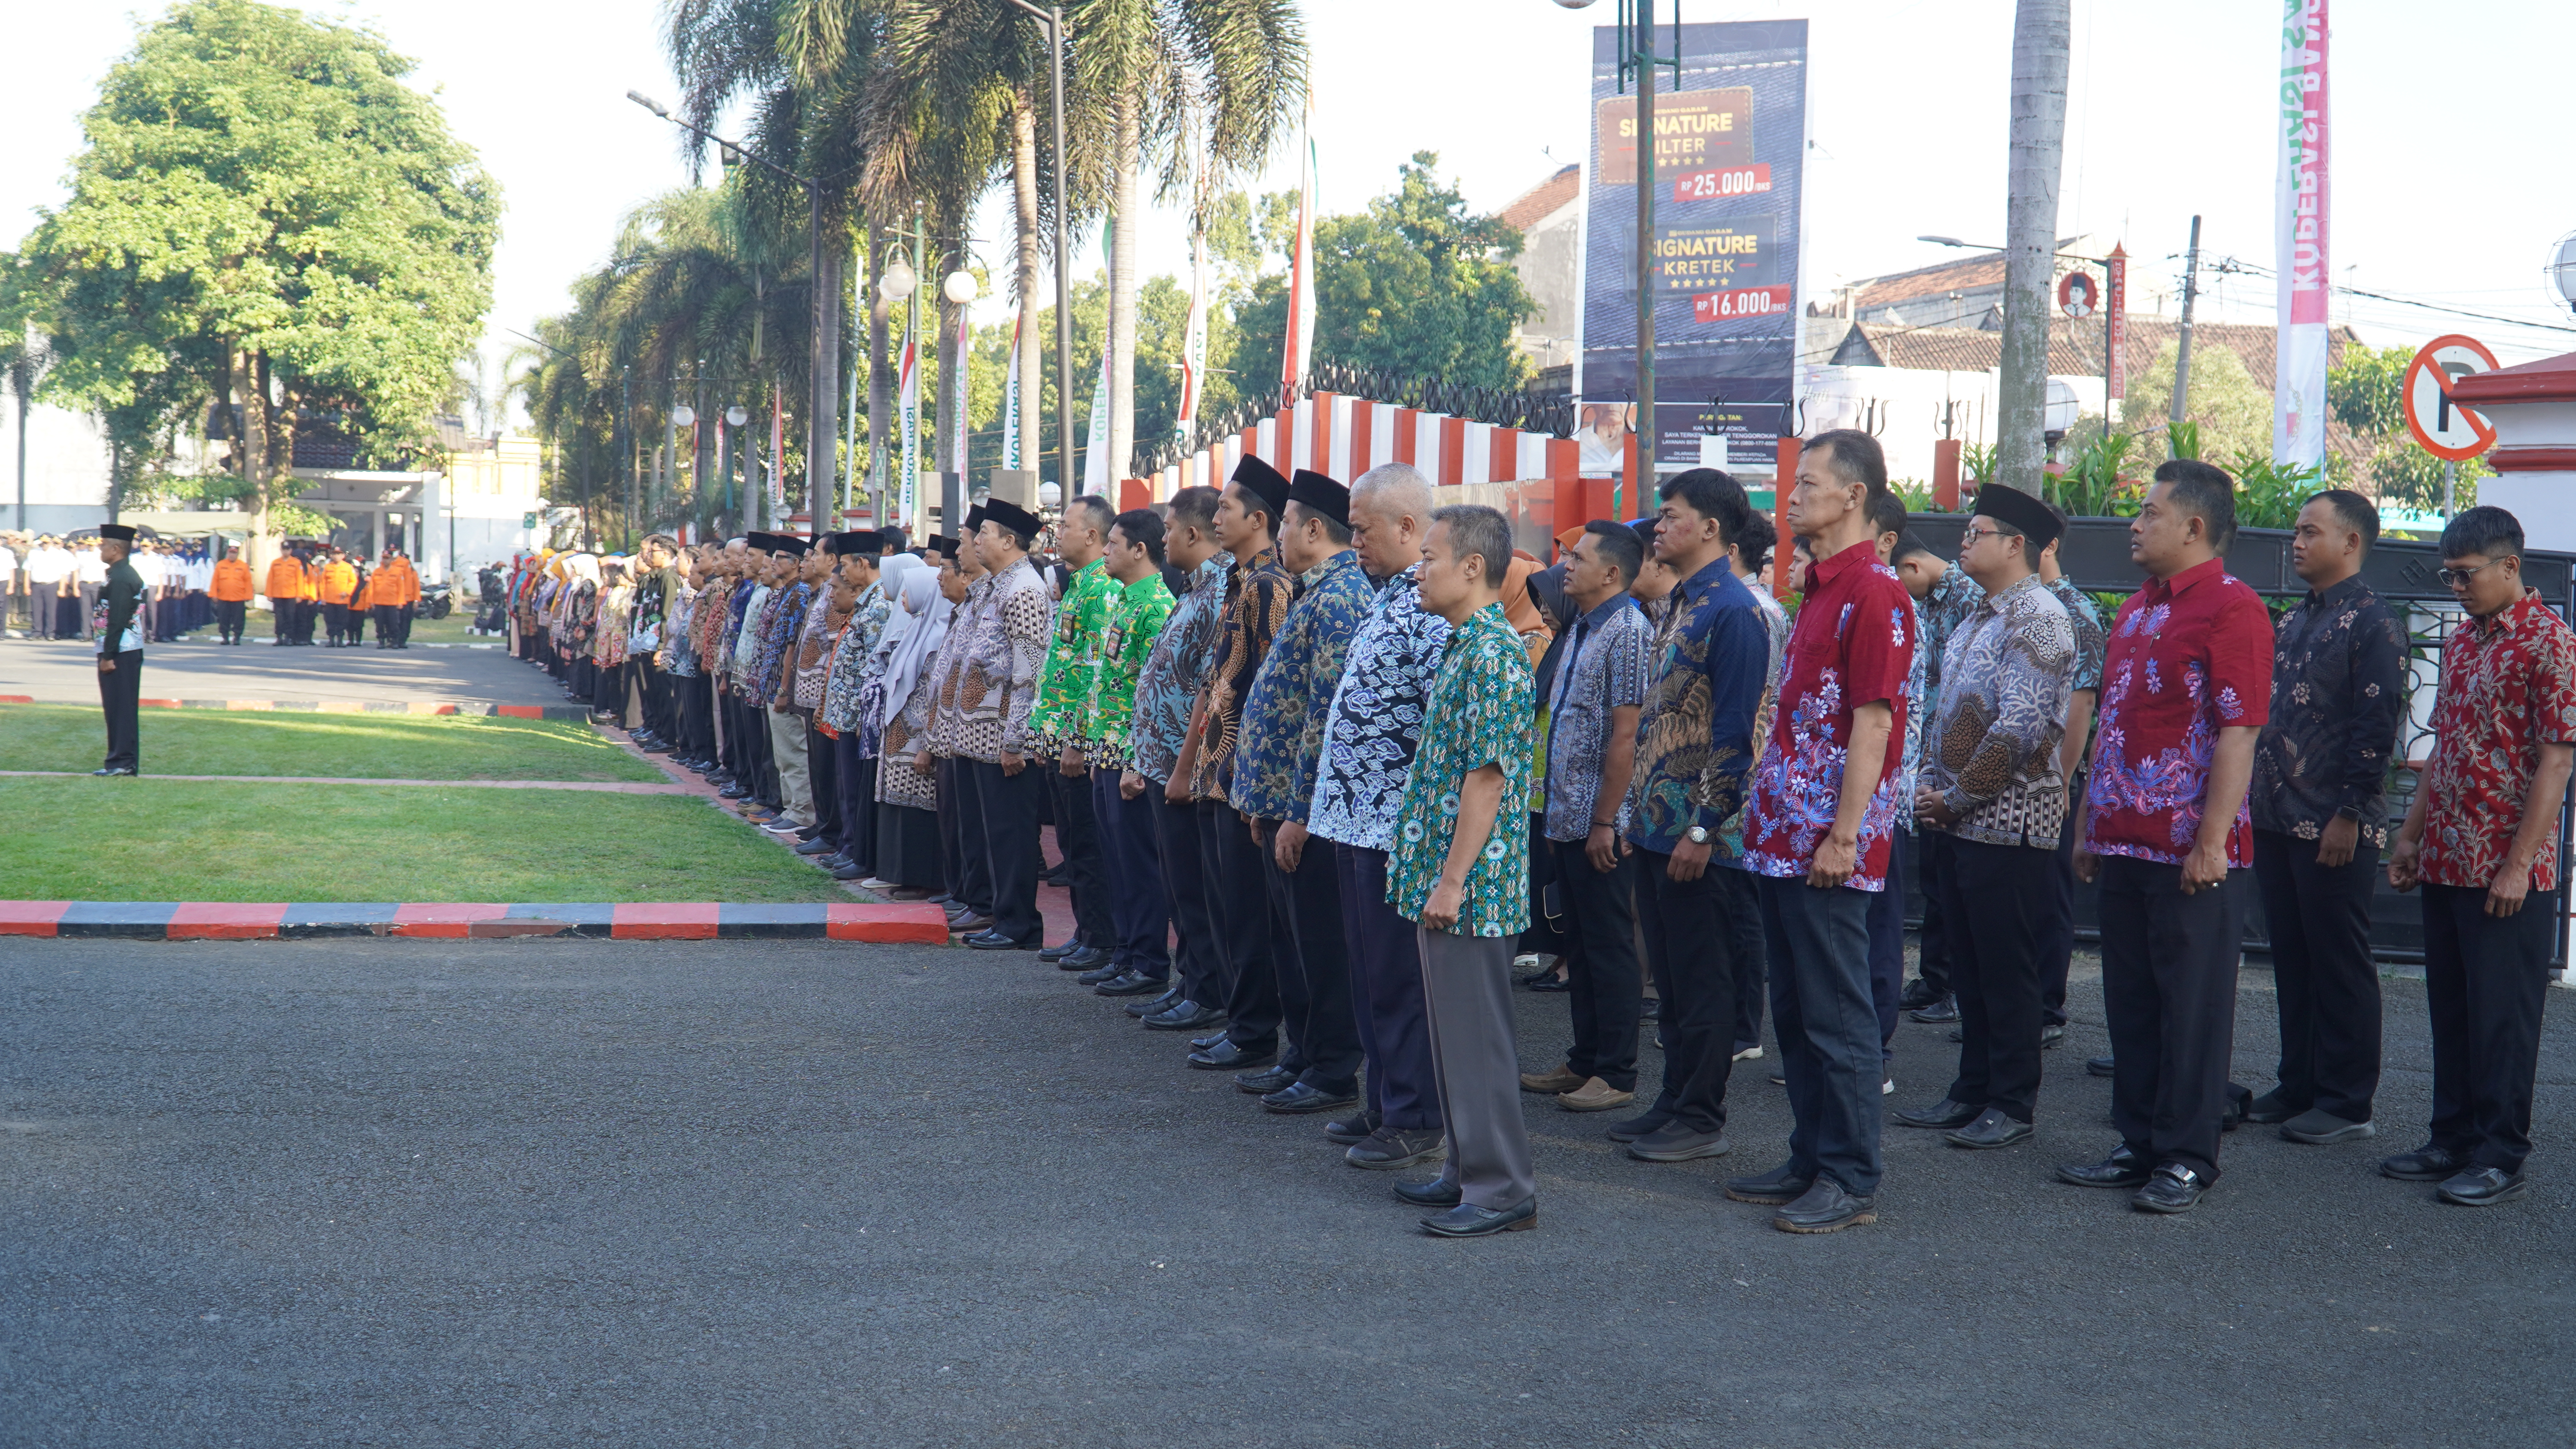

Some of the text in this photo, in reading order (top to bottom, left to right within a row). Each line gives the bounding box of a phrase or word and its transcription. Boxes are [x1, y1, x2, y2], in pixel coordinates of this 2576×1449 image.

[1619, 112, 1733, 137] SINATURE
[1656, 137, 1705, 154] ILTER
[1681, 181, 1692, 191] RP
[1694, 170, 1754, 196] 25.000
[1654, 235, 1758, 257] IGNATURE
[1664, 258, 1735, 276] KRETEK
[1697, 300, 1708, 311] RP
[1711, 291, 1771, 316] 16.000
